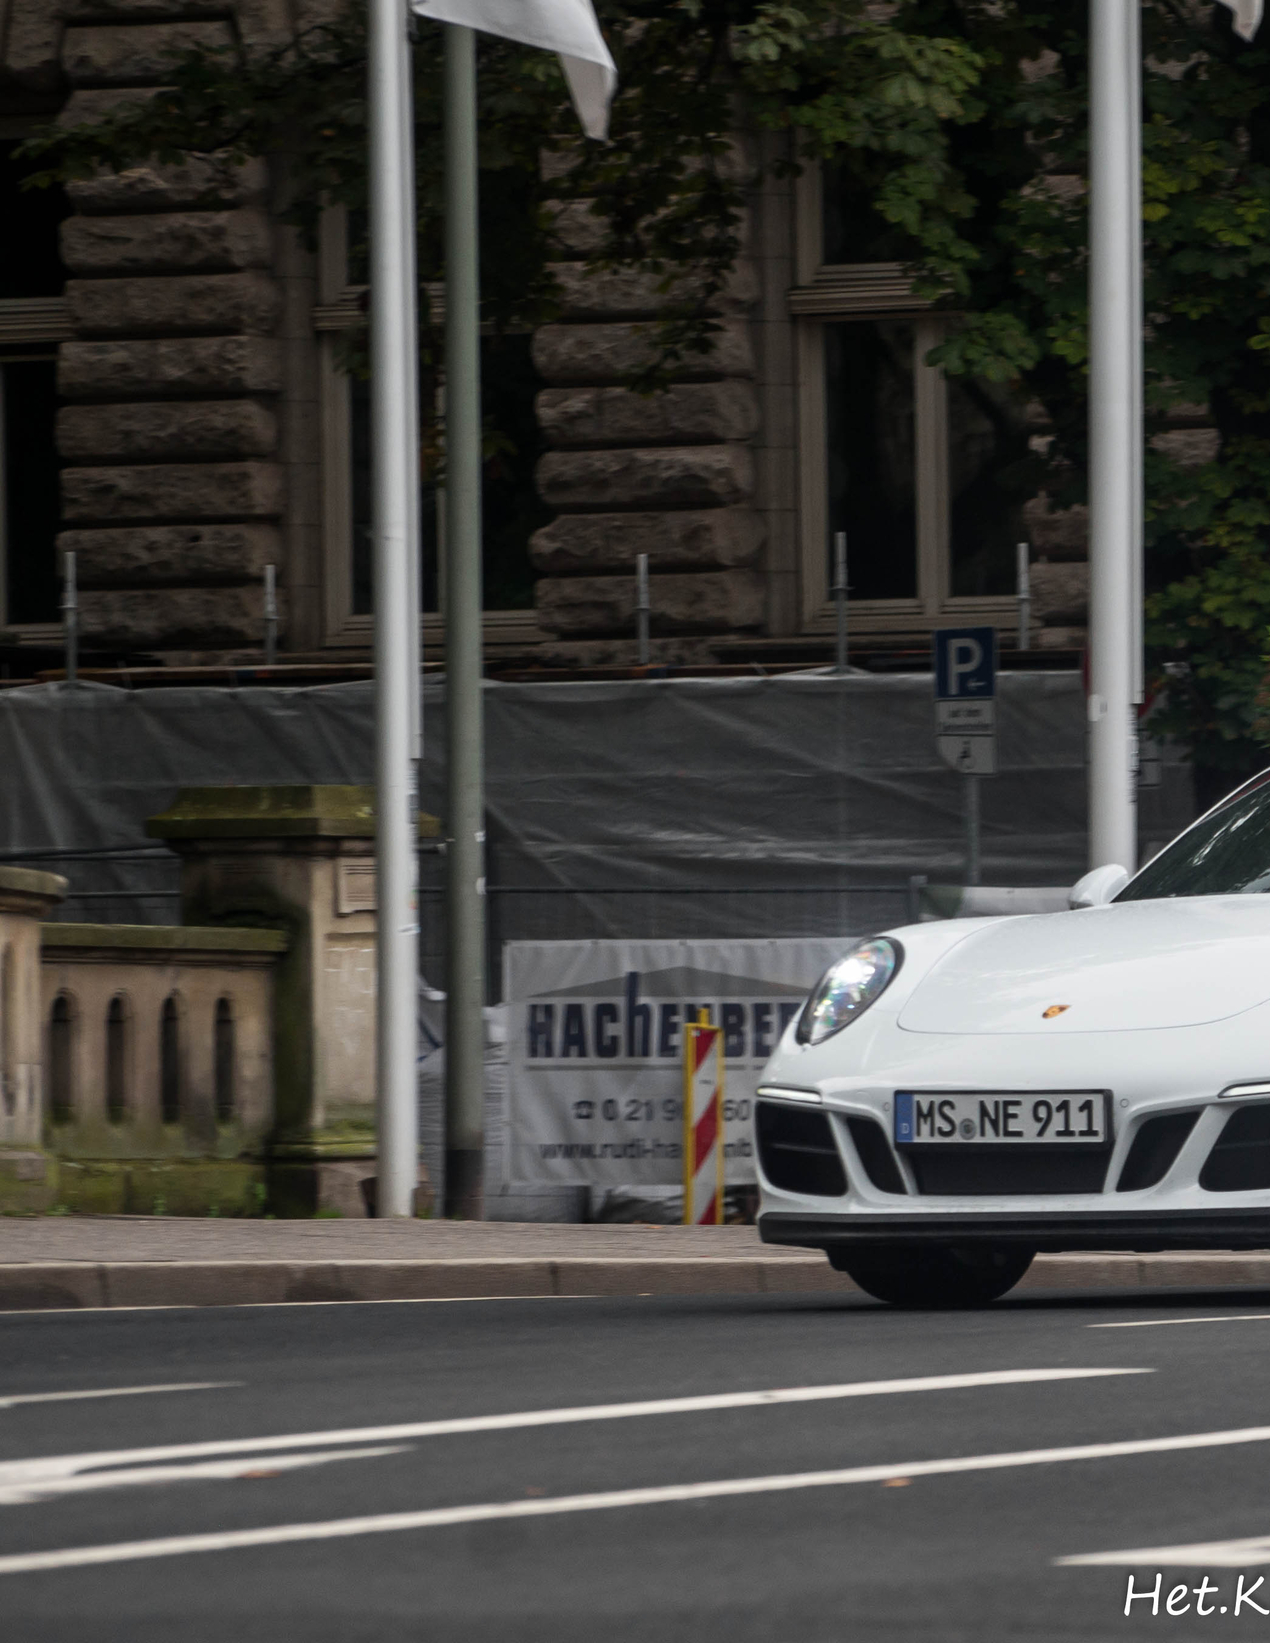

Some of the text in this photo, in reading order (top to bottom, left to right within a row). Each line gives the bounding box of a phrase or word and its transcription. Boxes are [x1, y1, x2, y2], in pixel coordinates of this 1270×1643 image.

[946, 637, 983, 695] P
[916, 1099, 1100, 1138] MS NE 911
